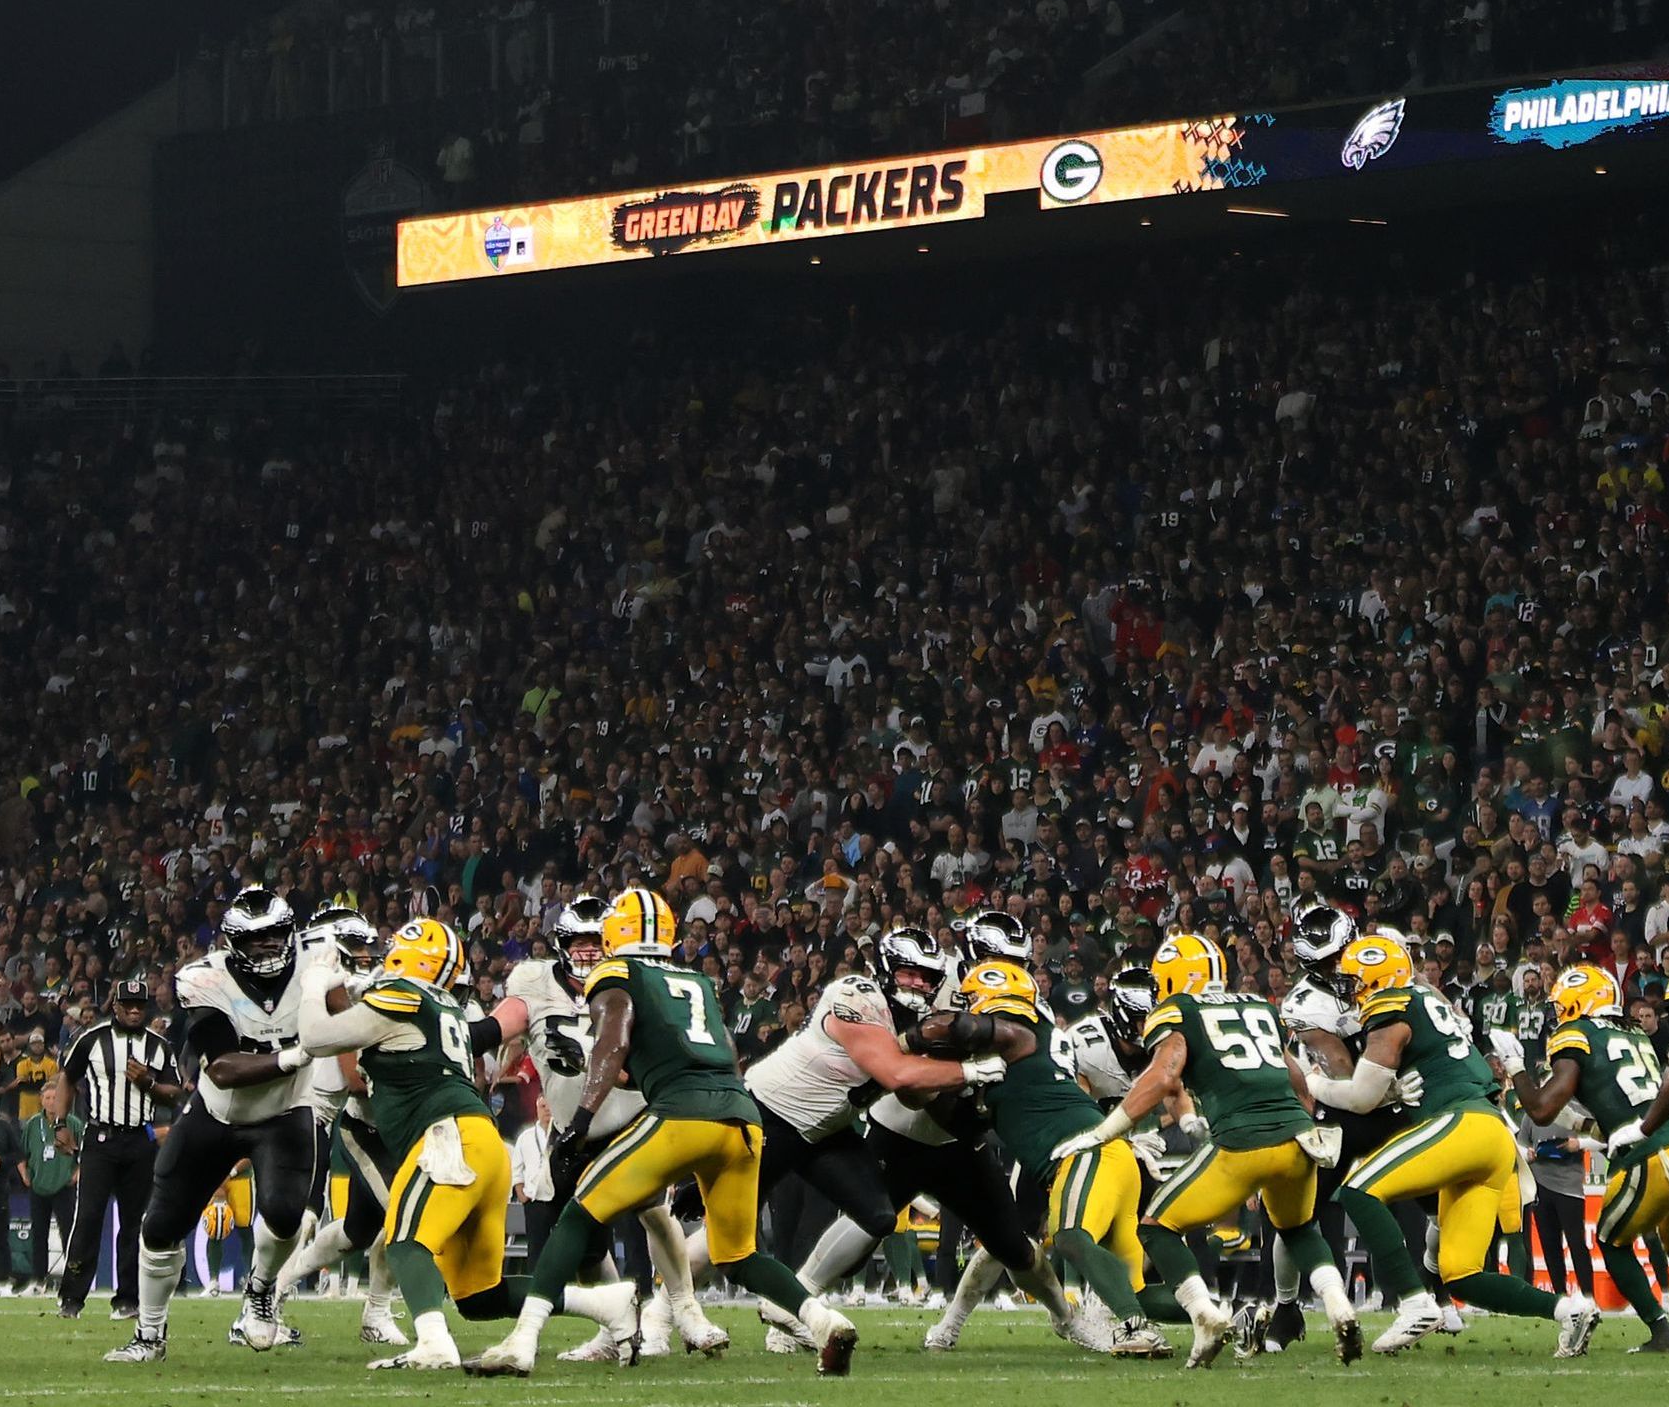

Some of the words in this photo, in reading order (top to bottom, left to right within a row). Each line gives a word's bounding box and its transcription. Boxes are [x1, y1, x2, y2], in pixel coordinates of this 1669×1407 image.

[624, 204, 702, 242] GREEN
[701, 200, 744, 232] BAY
[770, 161, 968, 235] PACKERS
[1010, 767, 1031, 790] 12
[1312, 840, 1338, 861] 12
[664, 975, 716, 1045] 7
[1076, 1026, 1105, 1049] 81
[1199, 1008, 1289, 1070] 58
[1520, 1013, 1545, 1041] 23
